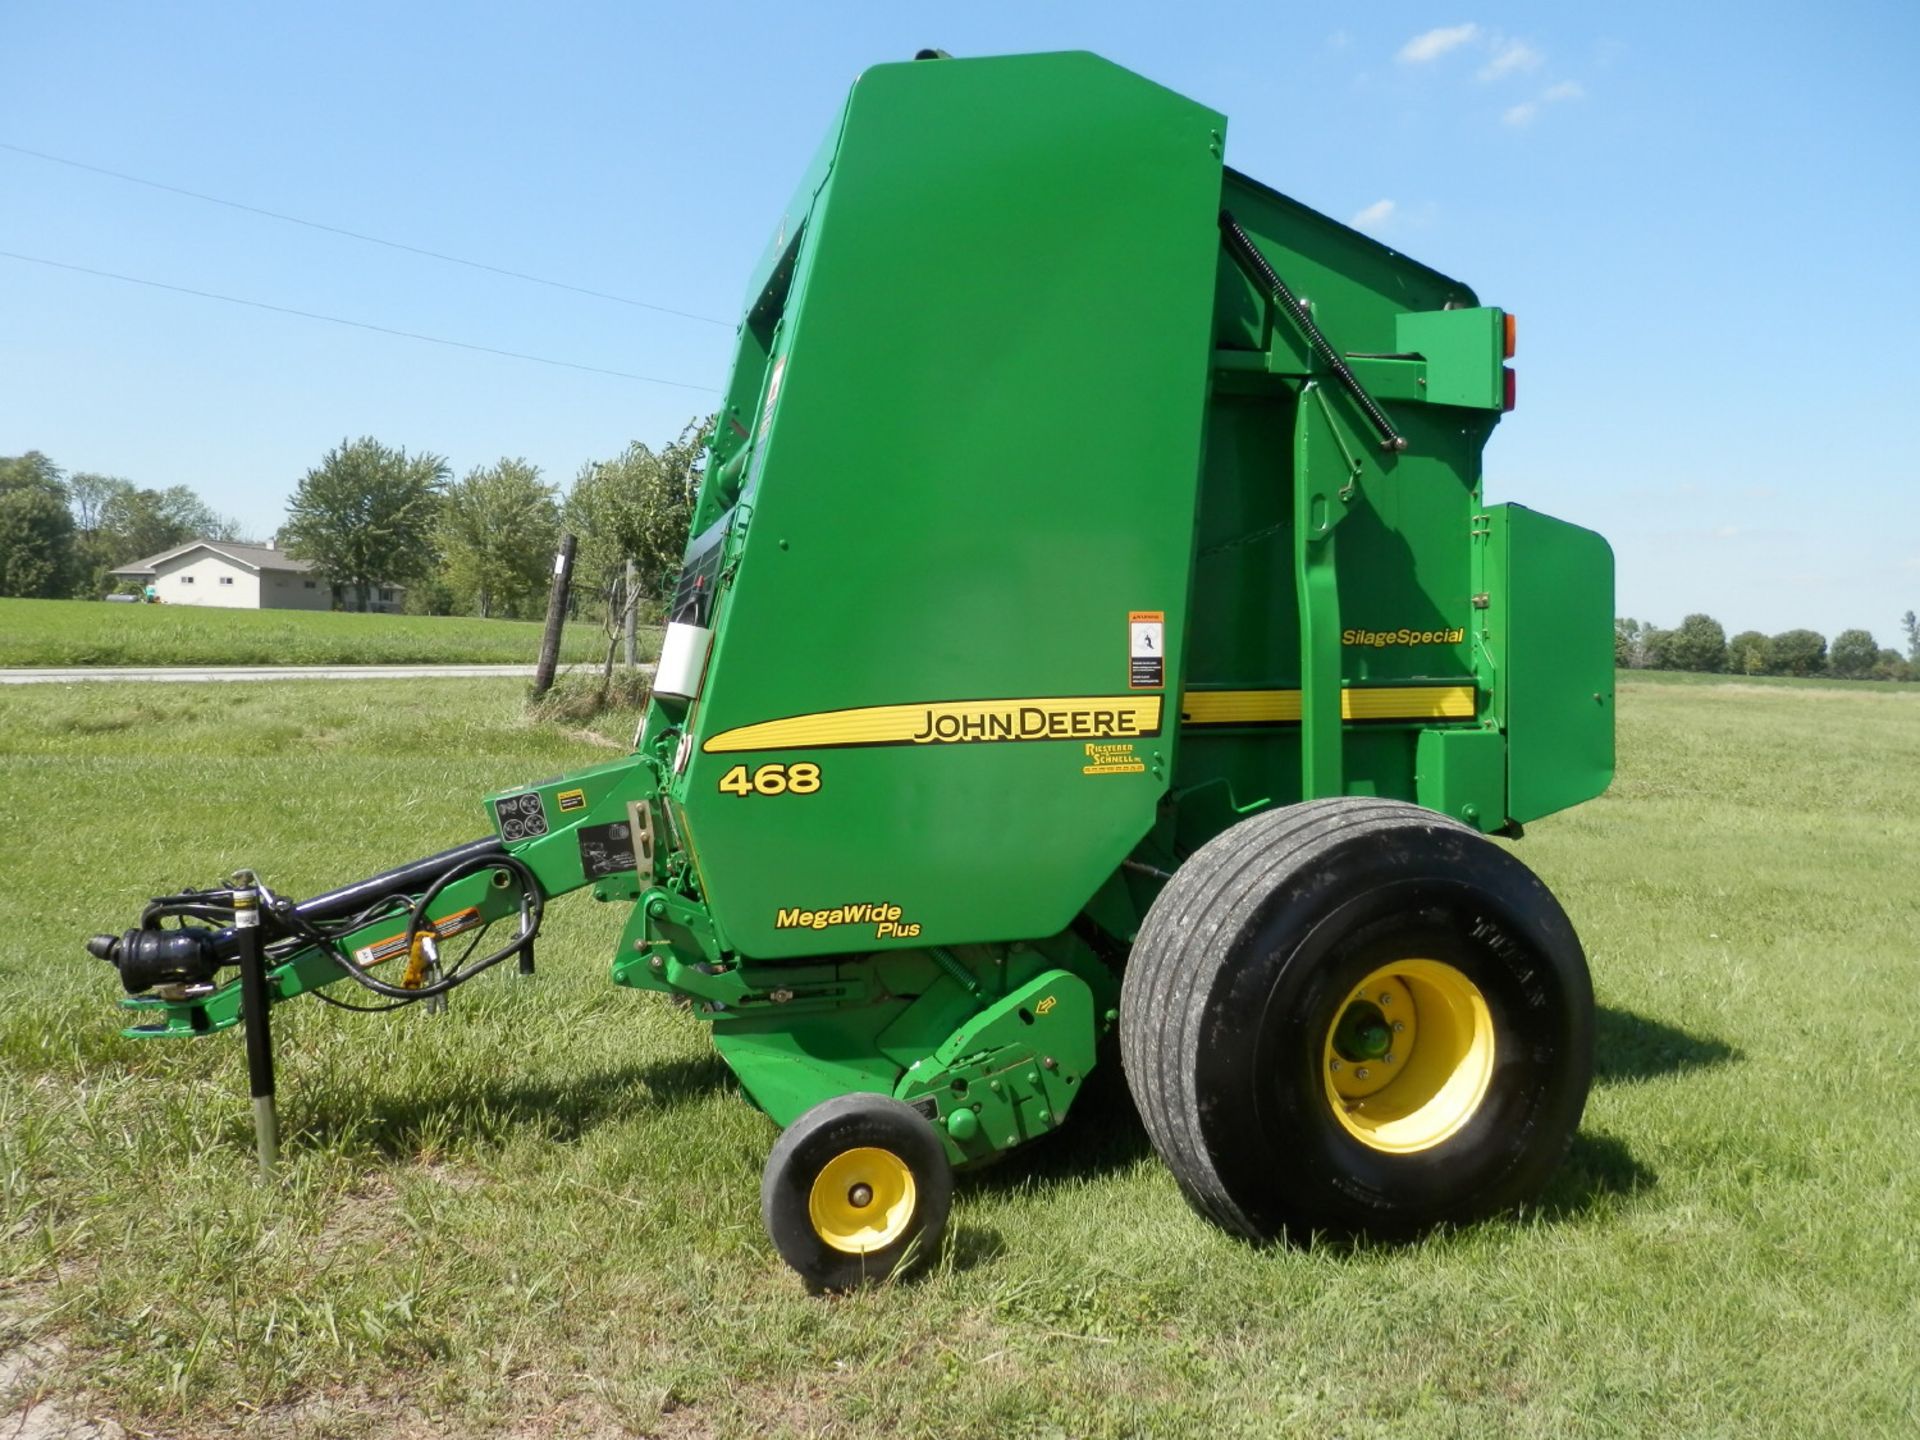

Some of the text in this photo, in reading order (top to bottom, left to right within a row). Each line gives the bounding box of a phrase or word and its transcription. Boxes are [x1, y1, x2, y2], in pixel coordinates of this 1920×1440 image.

[1342, 628, 1464, 648] SilageSpecial
[914, 708, 1136, 739] JOHN DEERE
[719, 762, 821, 796] 468
[776, 903, 902, 929] MegaWide
[876, 922, 921, 938] Plus
